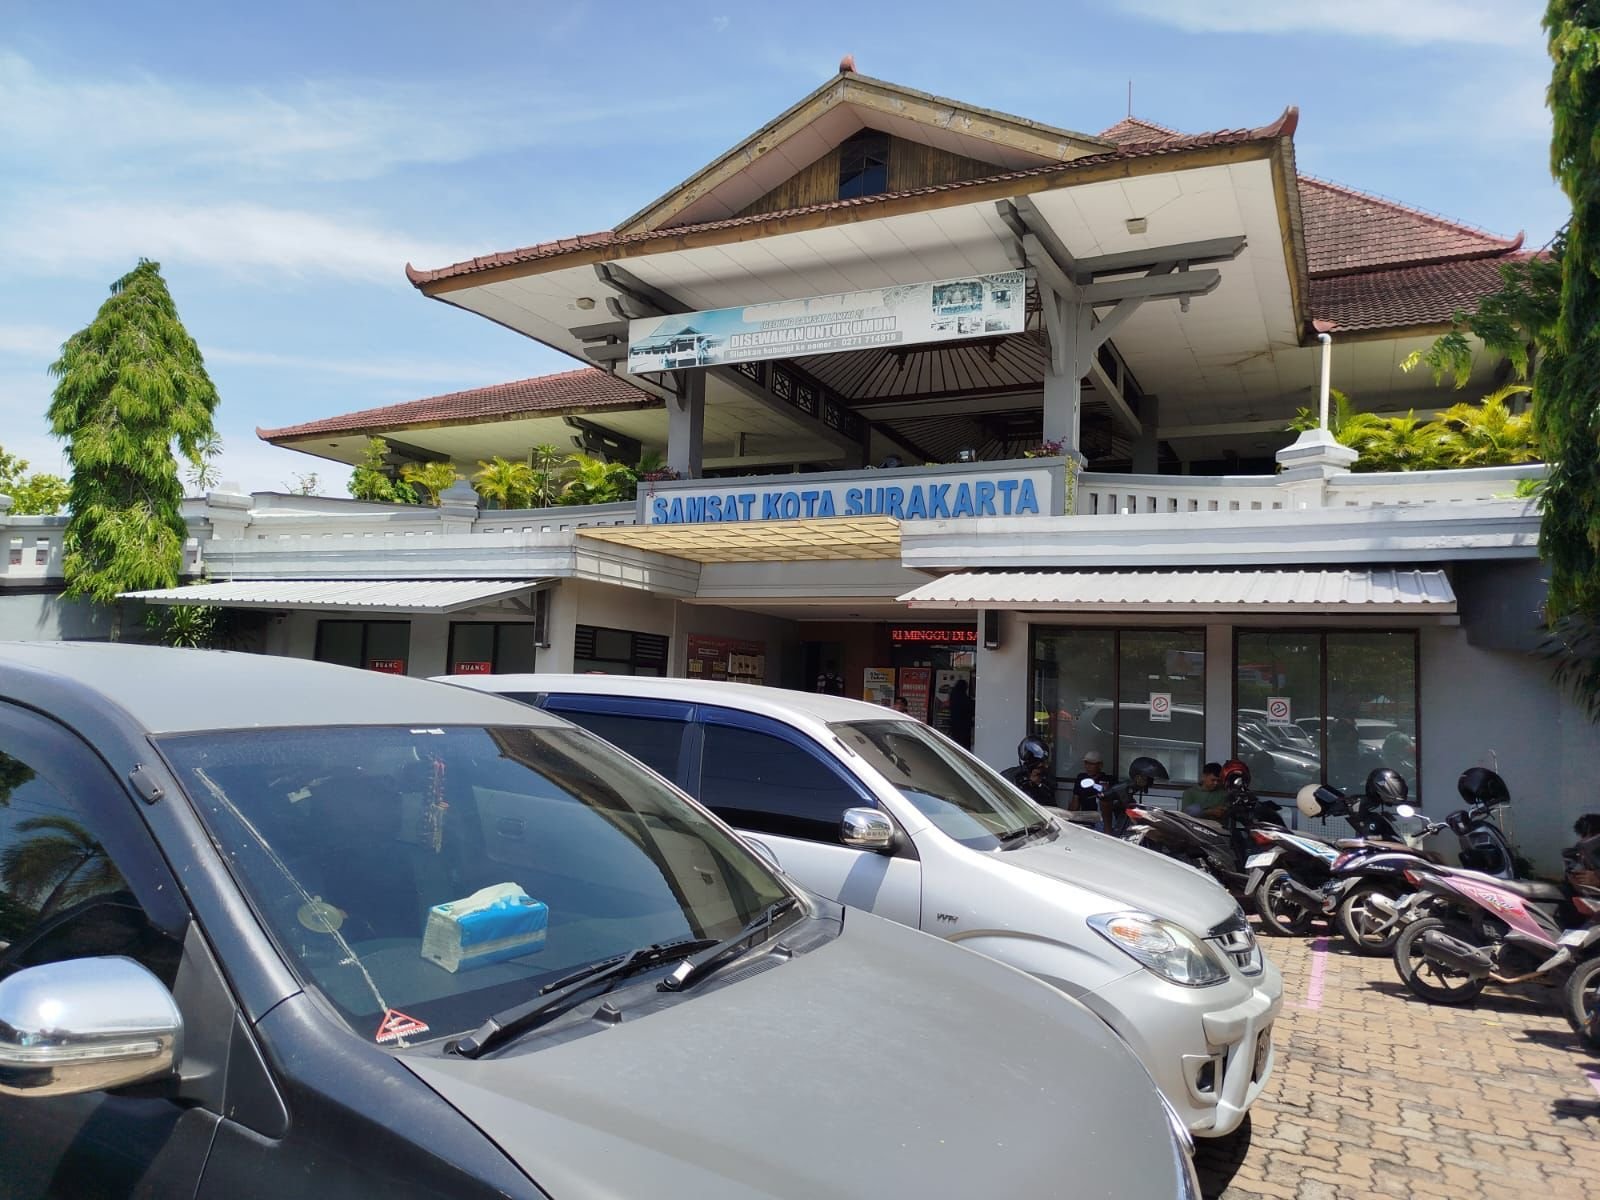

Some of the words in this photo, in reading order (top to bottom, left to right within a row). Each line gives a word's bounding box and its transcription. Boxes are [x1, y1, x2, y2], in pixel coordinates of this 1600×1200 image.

[730, 326, 804, 349] DISEWAKAN
[805, 320, 851, 341] UNTUK
[851, 315, 896, 335] UMUM
[652, 493, 756, 524] SAMSAT
[762, 490, 836, 520] KOTA
[845, 478, 1040, 520] SURAKARTA
[903, 630, 950, 640] MINGGU
